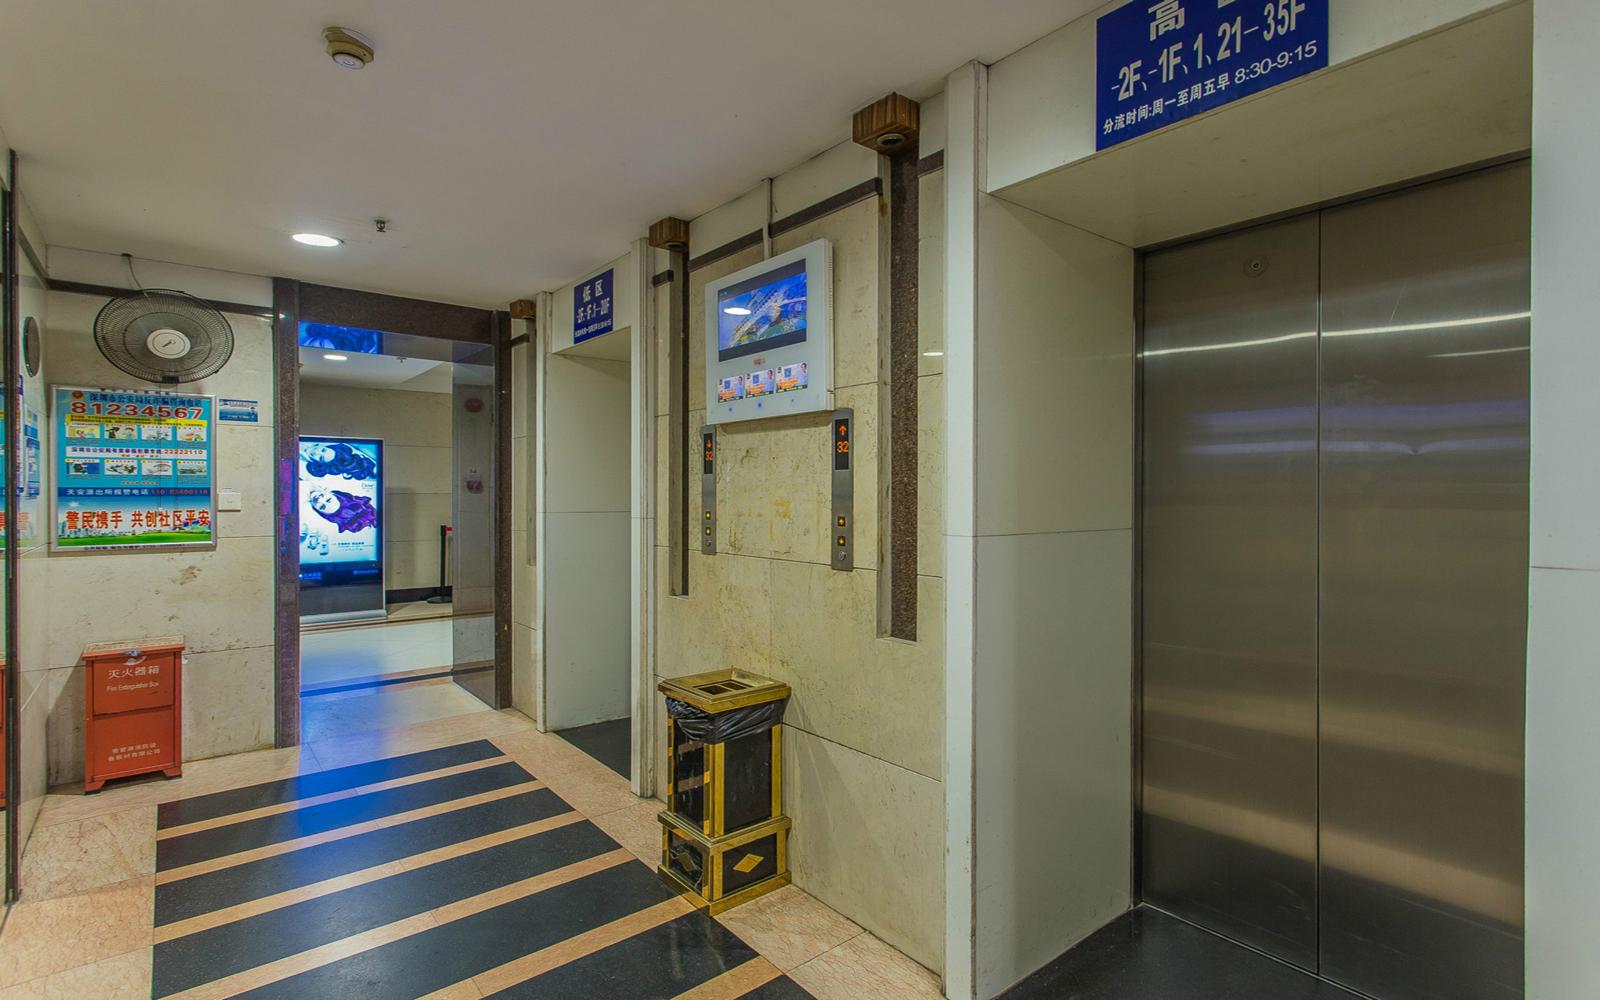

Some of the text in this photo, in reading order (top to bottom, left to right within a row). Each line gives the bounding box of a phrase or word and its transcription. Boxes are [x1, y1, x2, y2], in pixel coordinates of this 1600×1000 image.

[1103, 40, 1318, 135] 分流时间:周一至周五早 8:30-9:15
[70, 401, 204, 420] 81234567
[837, 441, 849, 453] 32
[705, 451, 713, 461] 32
[66, 509, 210, 530] 警民携手 共创社区平安
[108, 665, 160, 680] 灭火器箱
